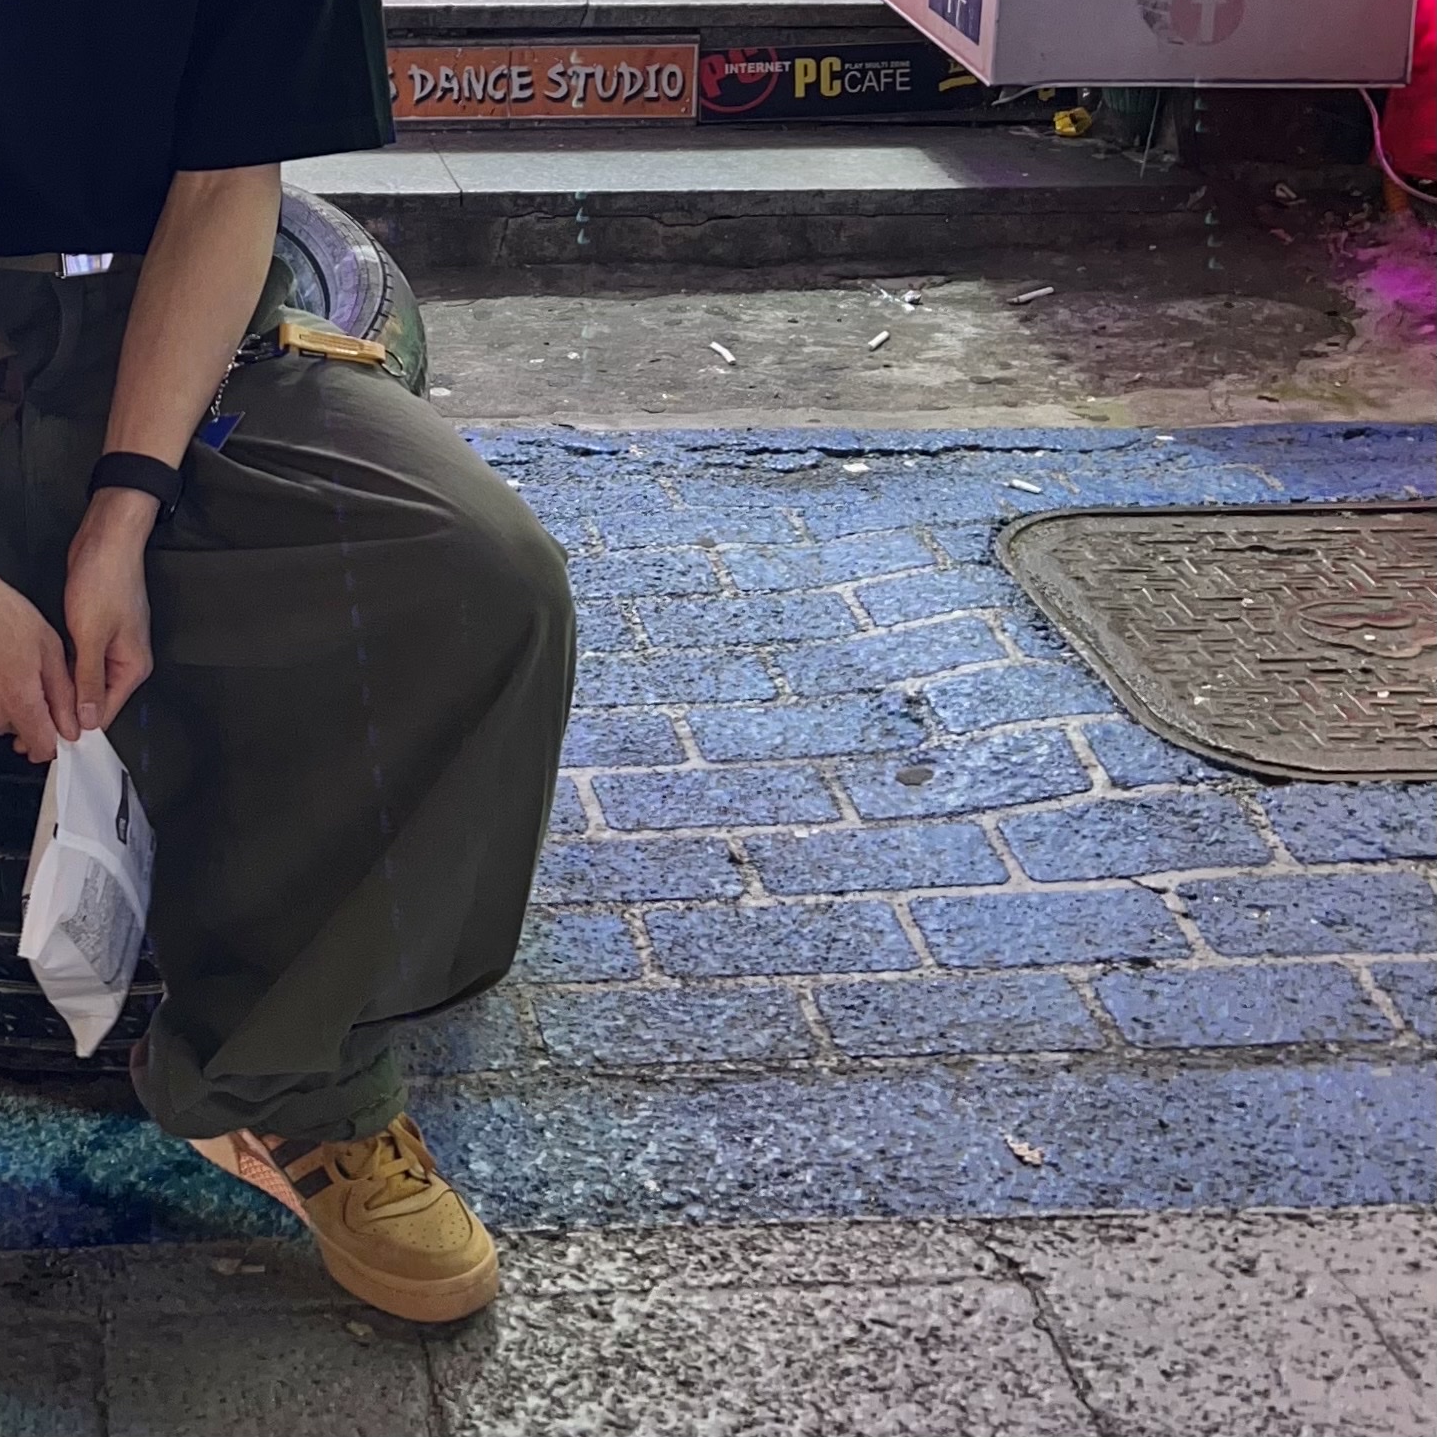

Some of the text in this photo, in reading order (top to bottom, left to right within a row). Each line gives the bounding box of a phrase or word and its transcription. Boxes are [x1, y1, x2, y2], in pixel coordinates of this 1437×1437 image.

[408, 64, 534, 105] DANCE
[544, 64, 684, 105] STUDIO
[724, 56, 911, 98] INTERNET PC CAFE
